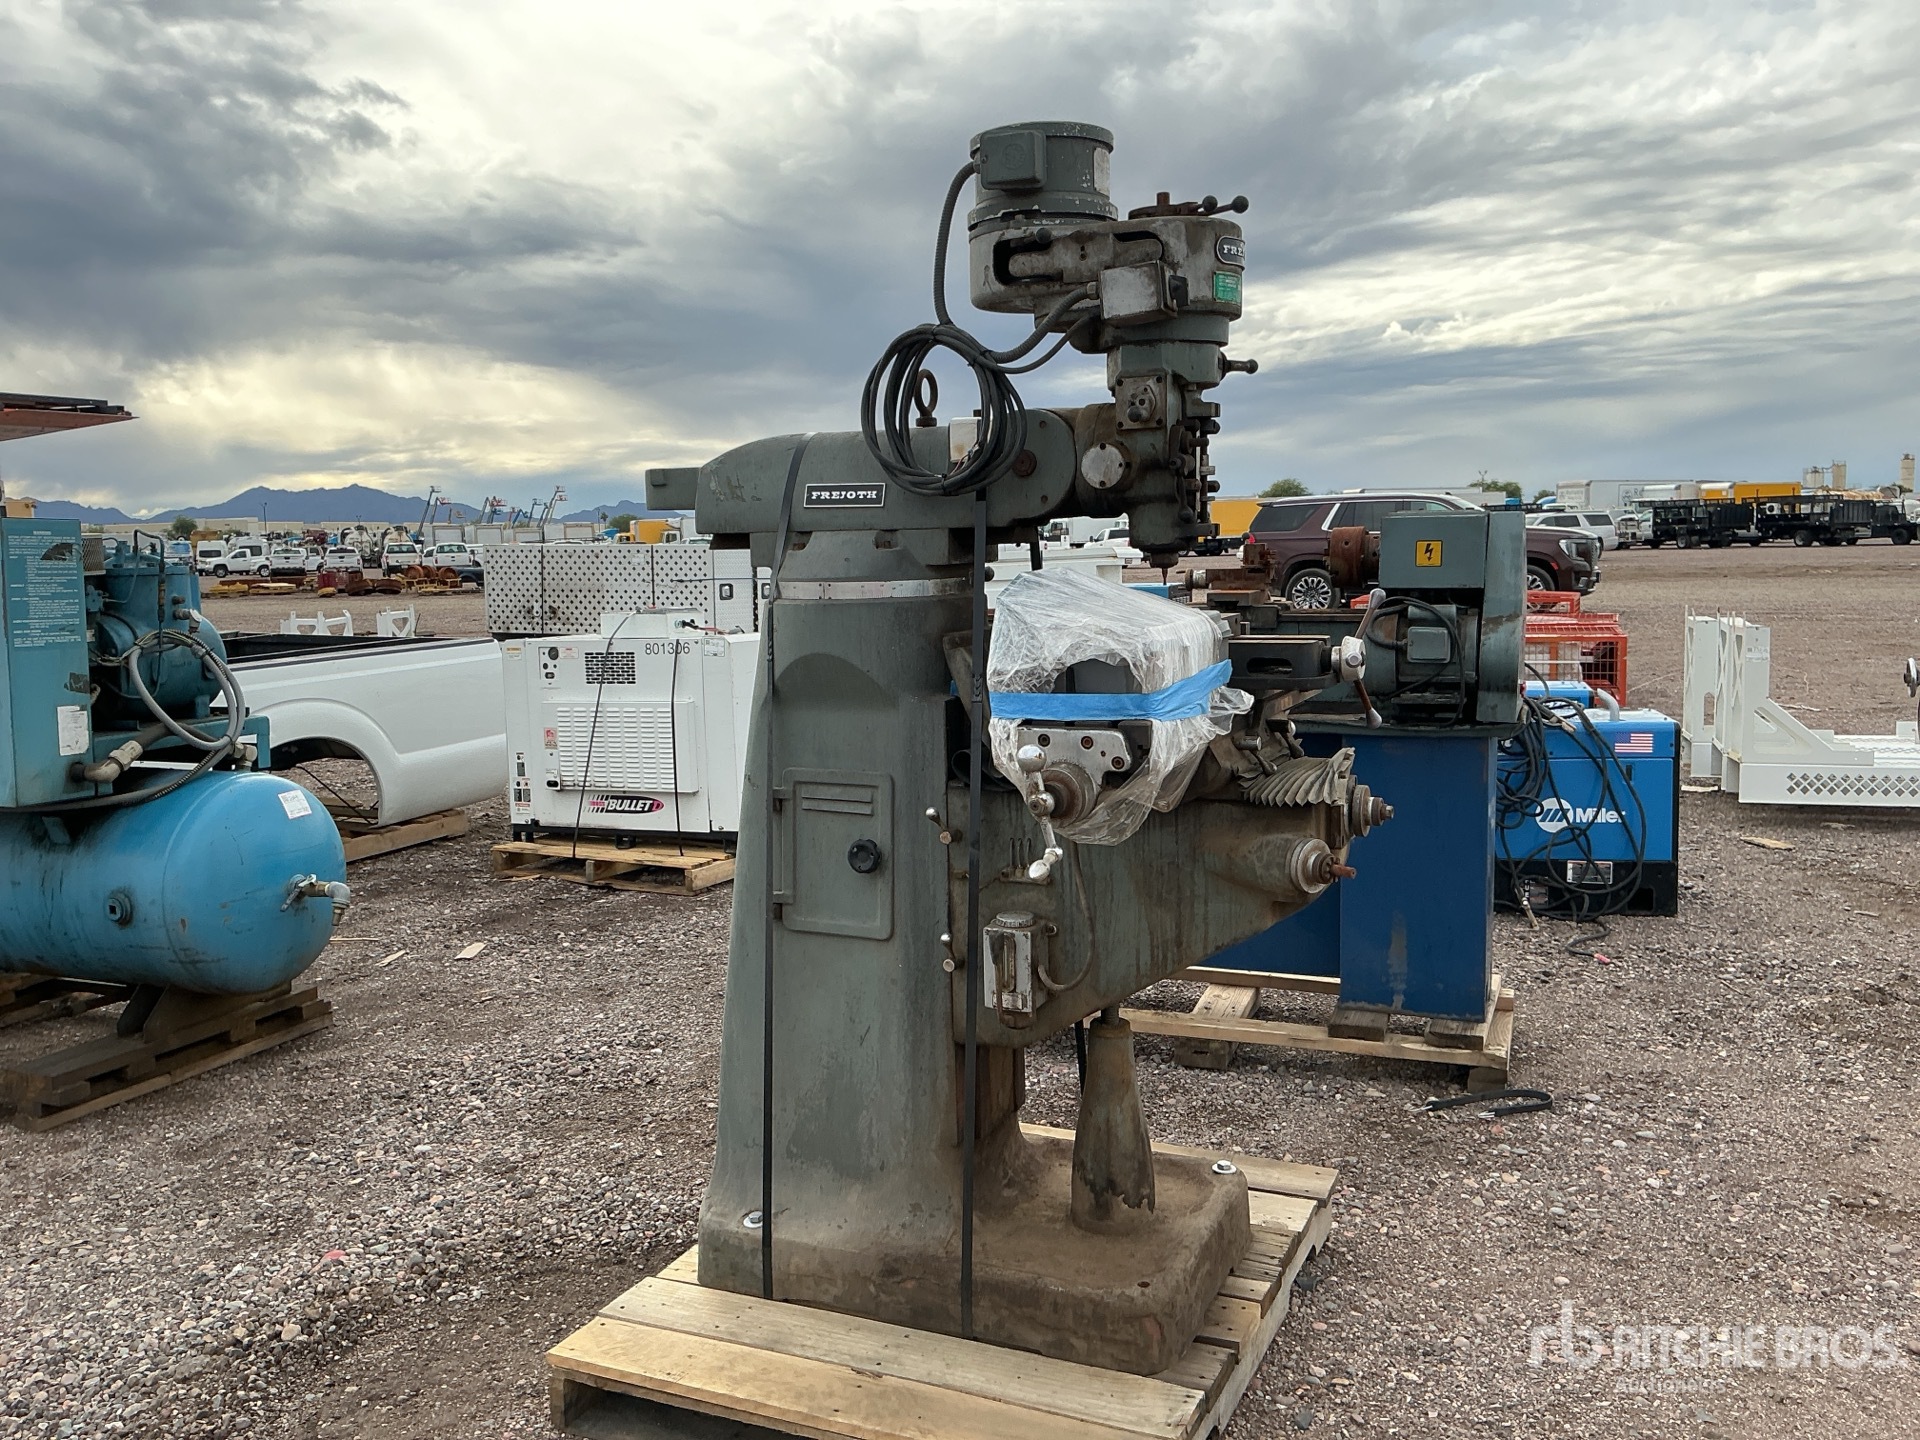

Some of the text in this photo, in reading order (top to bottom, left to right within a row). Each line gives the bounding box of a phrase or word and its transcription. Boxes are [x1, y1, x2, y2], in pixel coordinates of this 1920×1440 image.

[1223, 245, 1245, 256] FRE
[645, 641, 690, 655] 801306
[607, 799, 653, 811] BULLET
